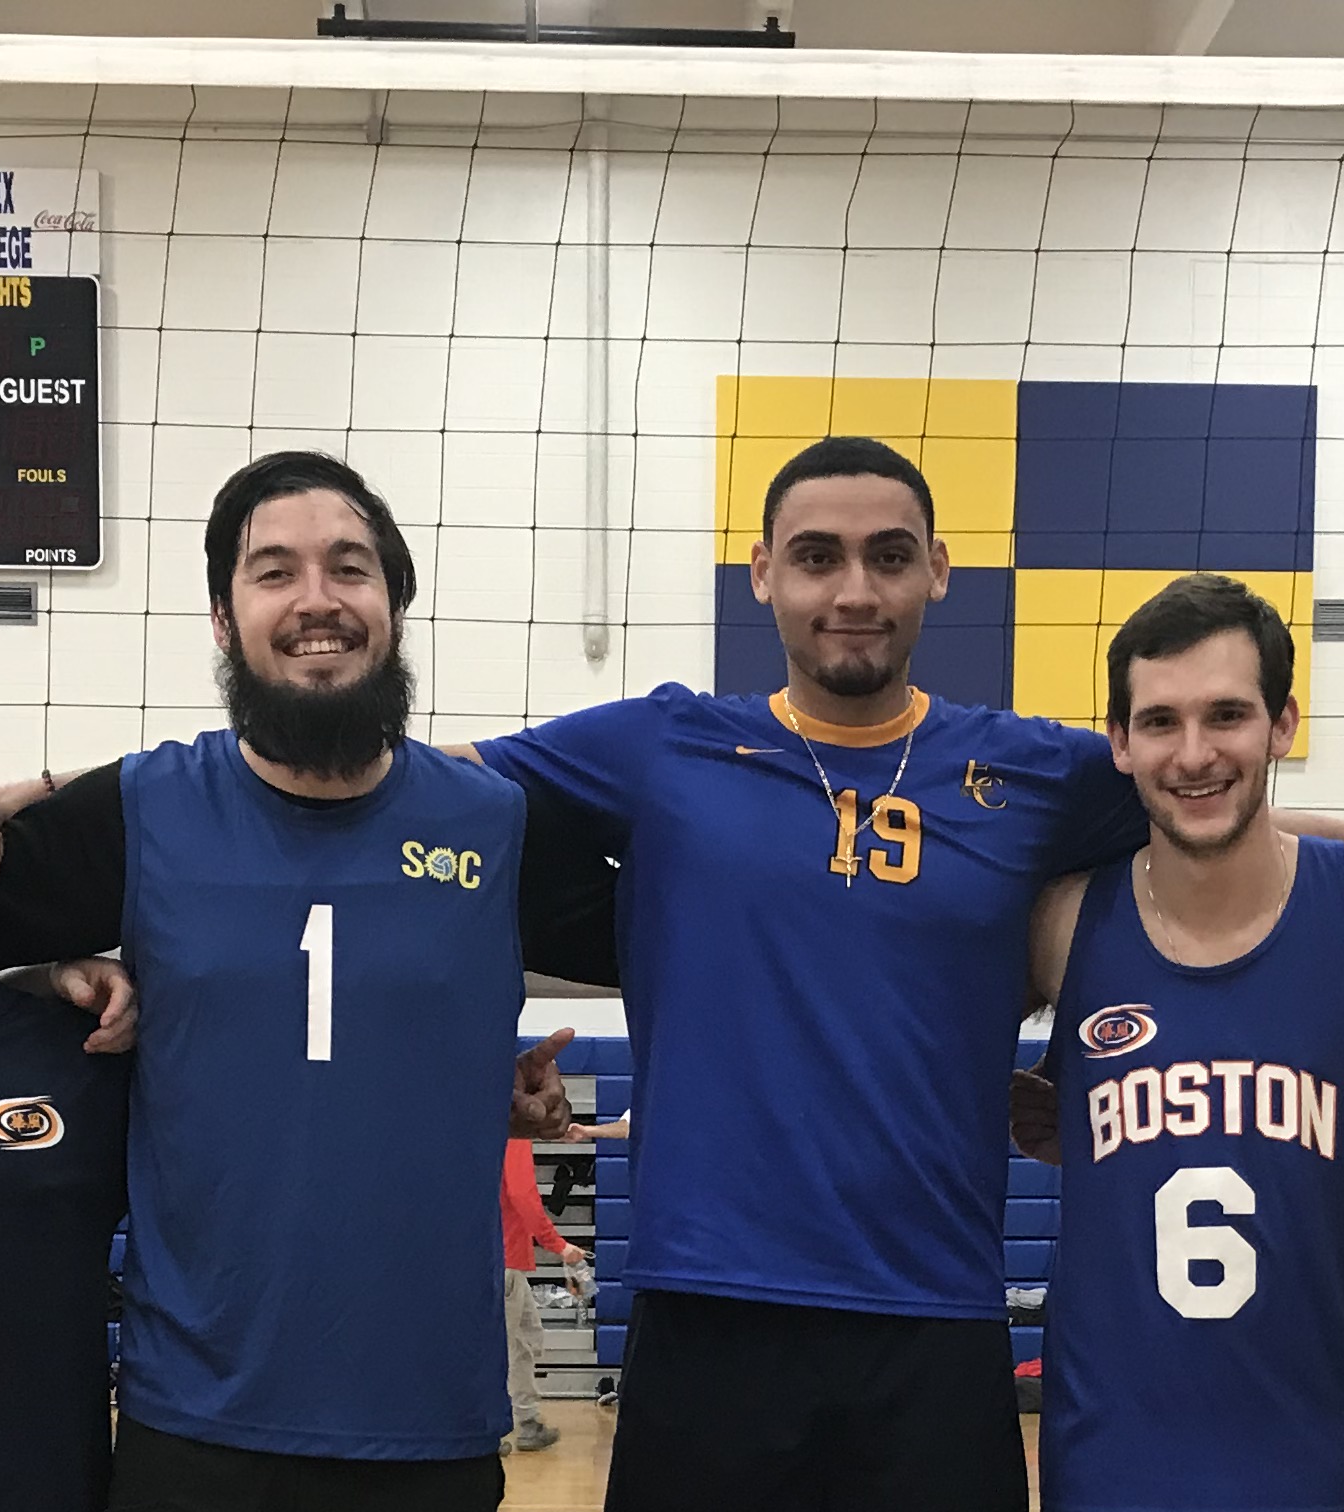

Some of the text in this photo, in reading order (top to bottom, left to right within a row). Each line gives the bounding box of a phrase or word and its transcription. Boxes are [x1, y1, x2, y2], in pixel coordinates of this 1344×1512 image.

[30, 337, 45, 356] P
[0, 378, 86, 405] GUEST
[17, 469, 67, 483] FOULS
[25, 548, 77, 563] POINTS
[829, 788, 922, 884] 19
[299, 903, 333, 1062] 1
[1088, 1060, 1338, 1164] BOSTON
[1154, 1166, 1257, 1319] 6
